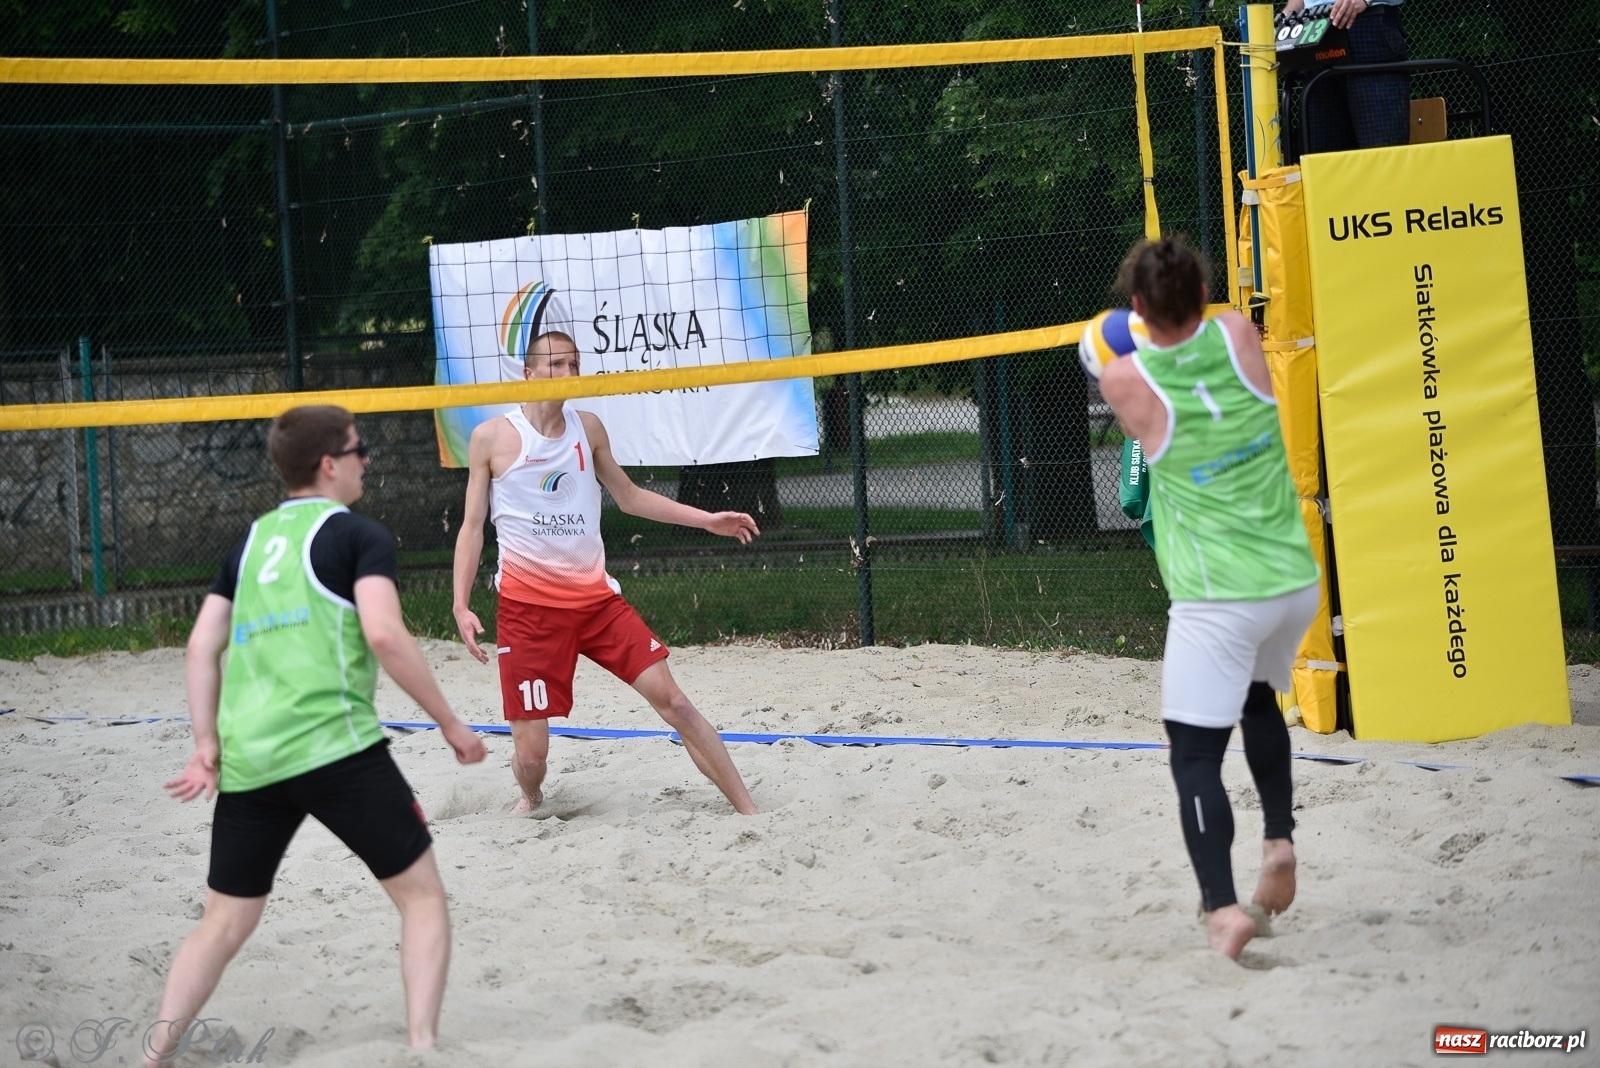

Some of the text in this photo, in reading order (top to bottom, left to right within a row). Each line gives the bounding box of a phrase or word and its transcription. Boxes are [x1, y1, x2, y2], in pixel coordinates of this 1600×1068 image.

[1315, 48, 1345, 60] molten
[1329, 203, 1504, 241] UKS Relaks
[593, 301, 707, 363] ŚLĄSKA
[1192, 381, 1221, 421] 1
[574, 441, 585, 471] 1
[1414, 264, 1467, 679] Siatkówka plażowa dla każdego
[1129, 465, 1140, 486] KLUB
[532, 511, 585, 529] ŚLĄSKA
[532, 525, 585, 536] SIATKÓWKA
[257, 535, 287, 584] 2
[518, 678, 549, 711] 10
